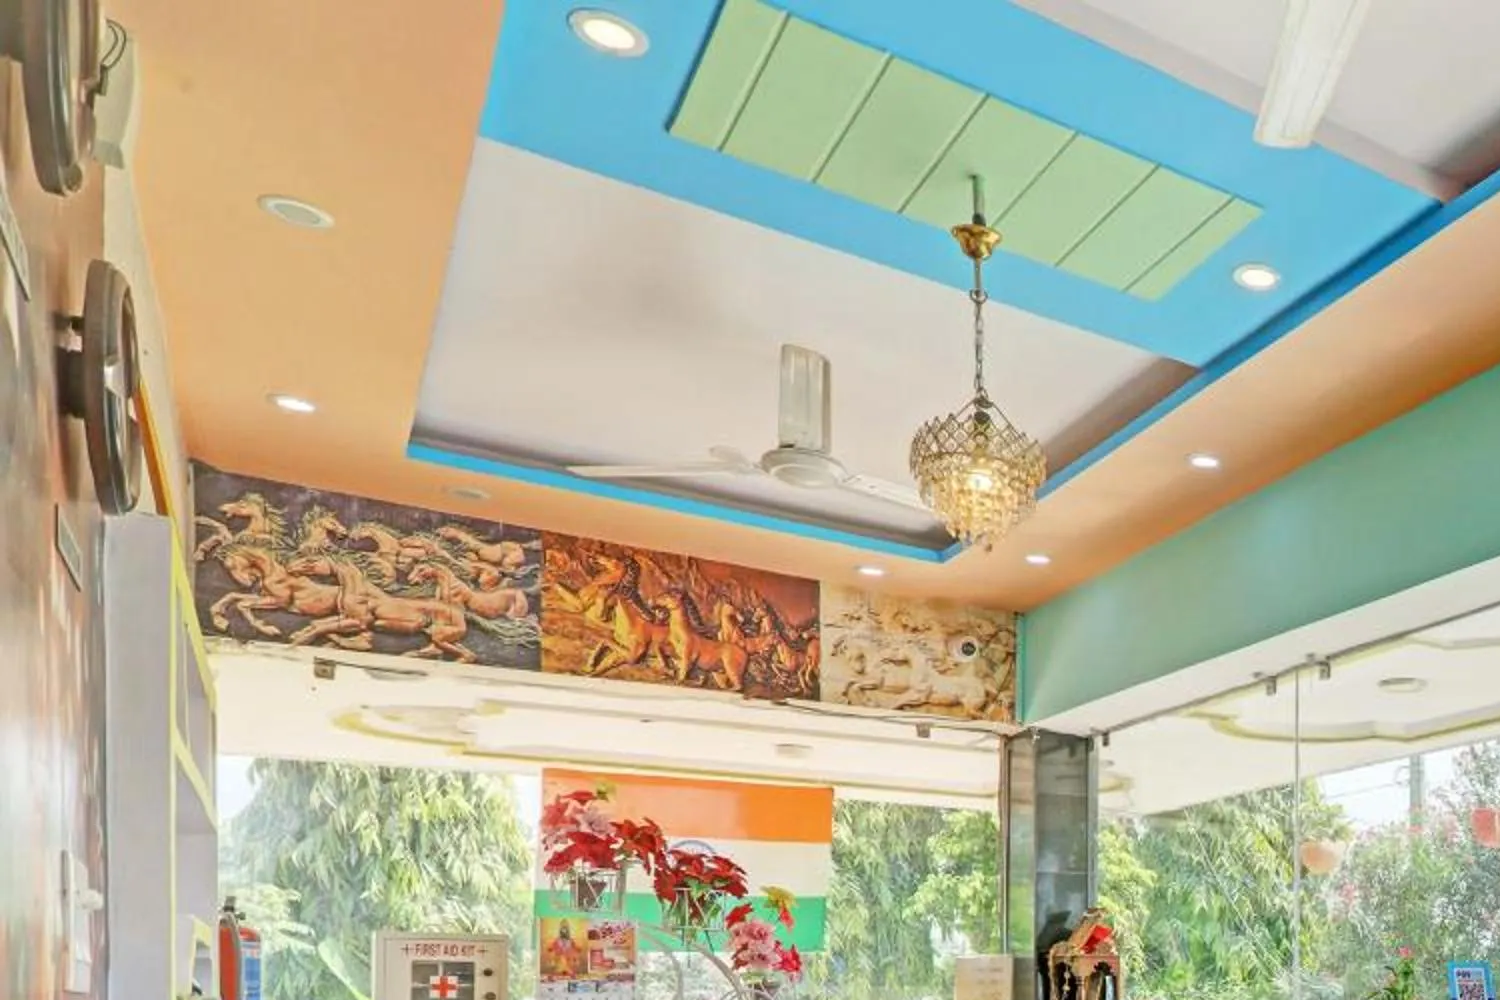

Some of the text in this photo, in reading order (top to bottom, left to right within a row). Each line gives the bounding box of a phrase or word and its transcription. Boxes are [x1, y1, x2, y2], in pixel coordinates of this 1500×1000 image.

[415, 943, 475, 957] FIRST AID KIT
